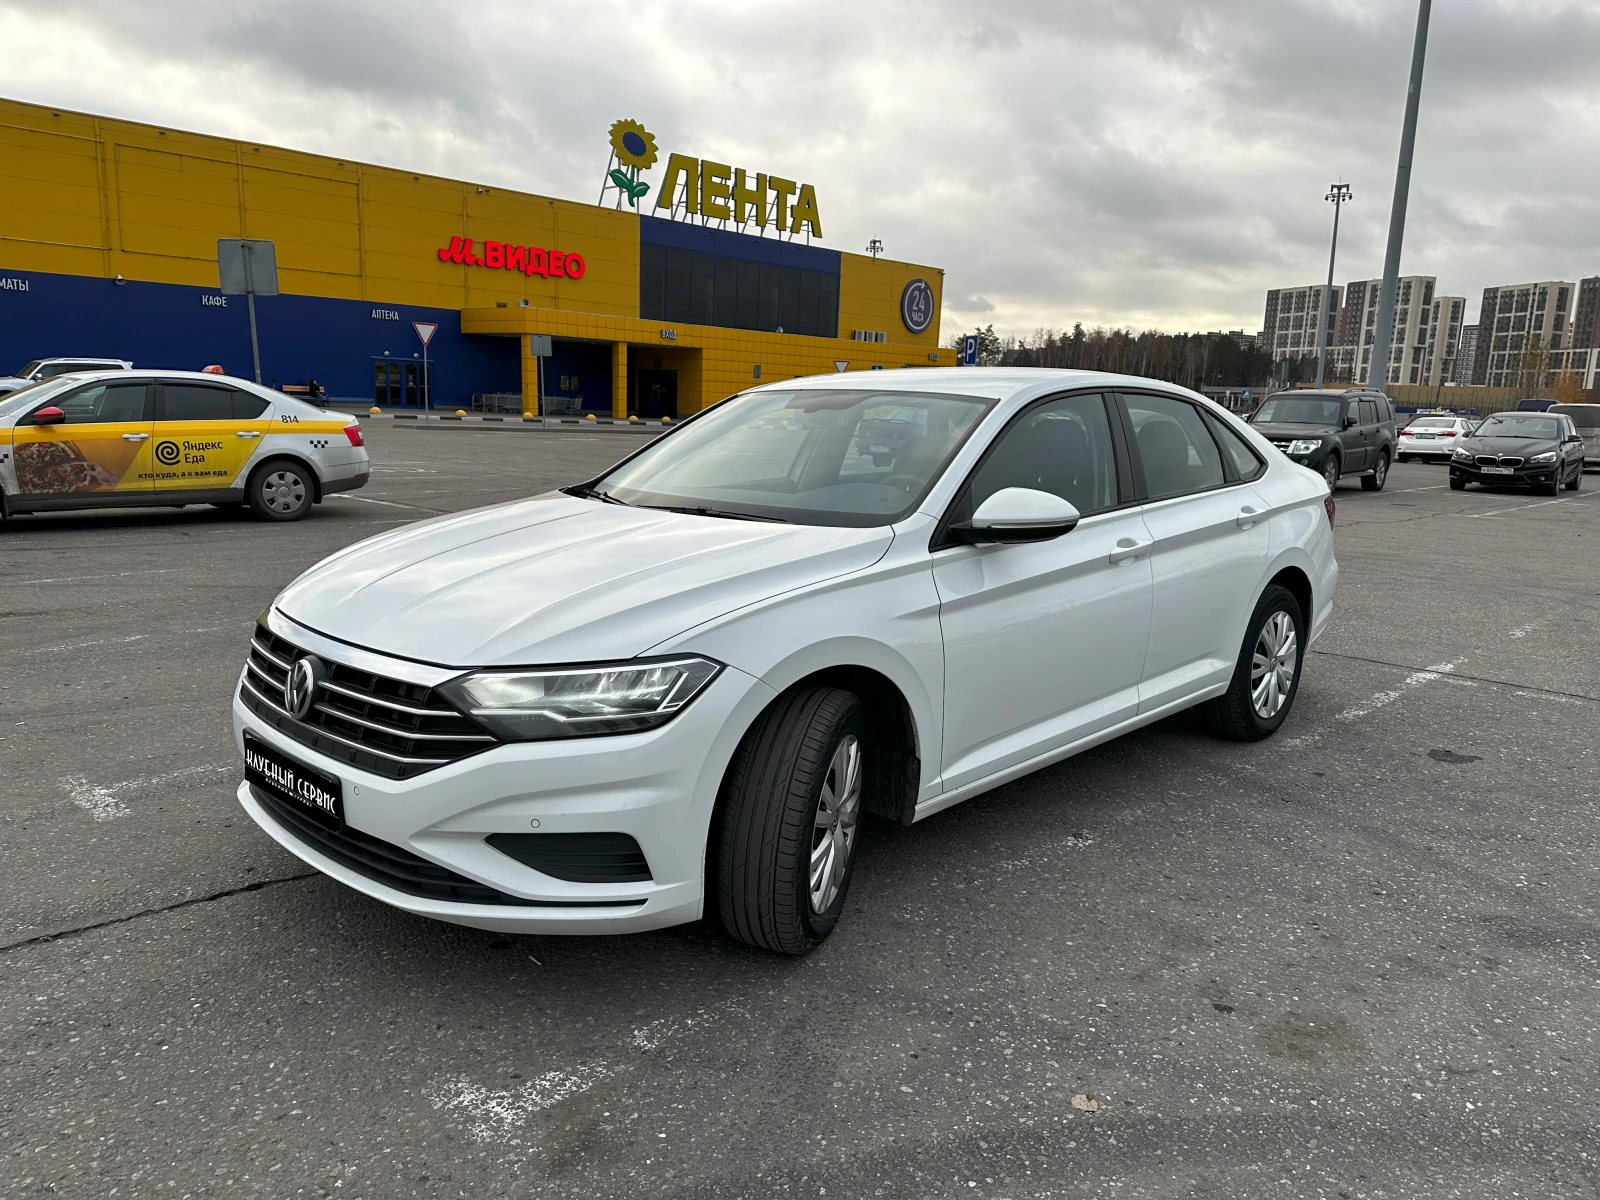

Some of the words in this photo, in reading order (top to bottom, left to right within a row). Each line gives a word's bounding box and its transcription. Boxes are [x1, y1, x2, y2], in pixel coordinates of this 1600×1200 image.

[657, 153, 823, 238] ЛЕНТА
[438, 236, 586, 279] М.ВИДЕО
[202, 295, 228, 307] КАФЕ
[912, 290, 925, 311] 24
[371, 309, 399, 320] АПТЕКА
[911, 311, 924, 322] ЧАСА
[281, 414, 299, 424] 814
[182, 440, 223, 452] Яндекс
[184, 453, 205, 464] Еда
[155, 471, 179, 480] куда,
[212, 469, 228, 477] еда
